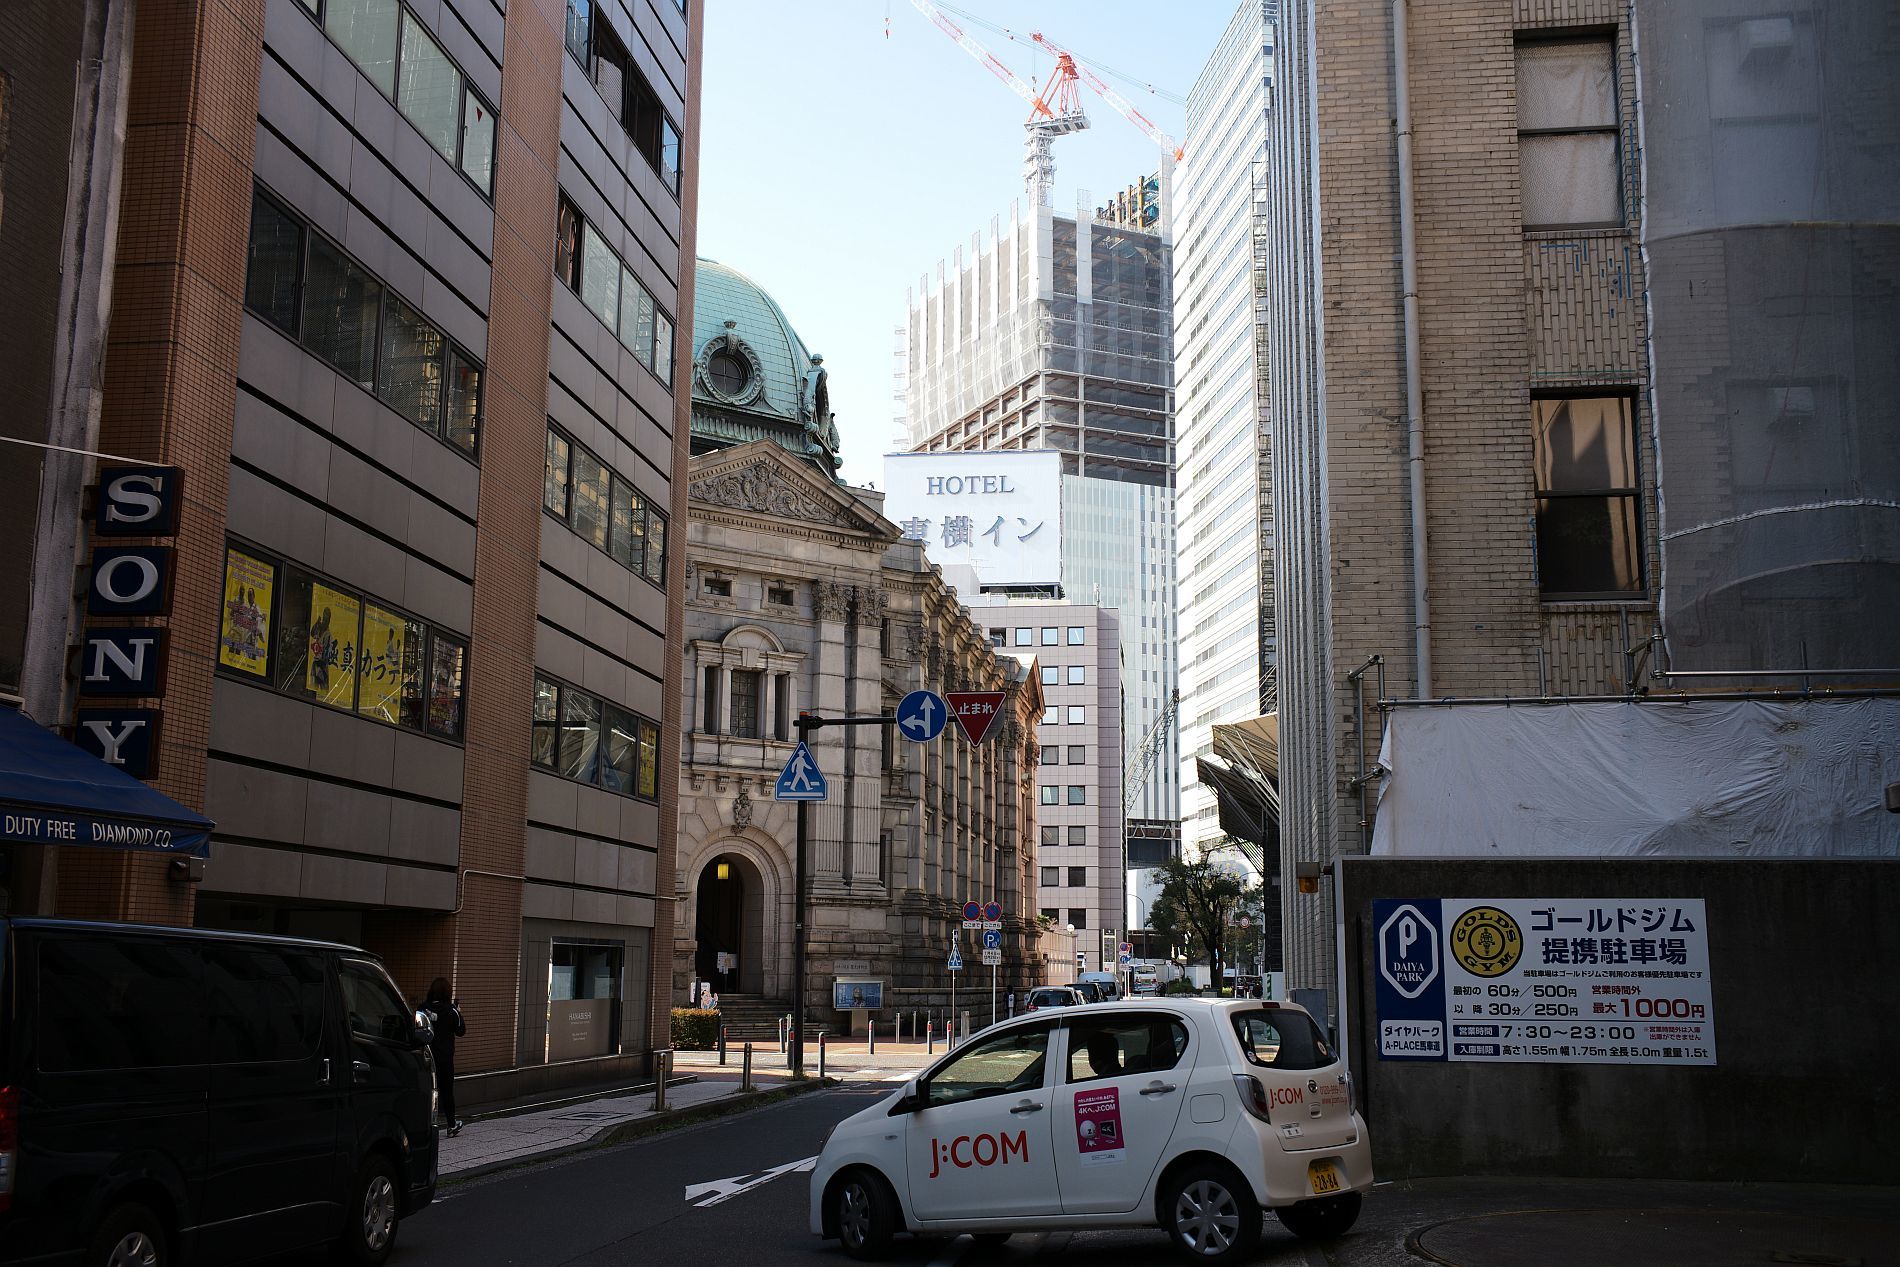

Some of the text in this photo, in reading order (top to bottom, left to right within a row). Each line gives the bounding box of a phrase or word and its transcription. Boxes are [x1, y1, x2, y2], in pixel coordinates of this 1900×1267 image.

[926, 475, 1015, 496] HOTEL
[900, 515, 1044, 549] 東横イン
[82, 474, 163, 764] SONY
[957, 702, 994, 715] 止まれ
[5, 815, 41, 838] DUTY
[46, 818, 76, 840] FREE
[91, 821, 154, 847] DIAMOND
[1457, 912, 1517, 943] GOLD'S
[1531, 907, 1696, 933] ゴールドジム
[987, 935, 995, 947] P
[1541, 937, 1688, 965] 提携駐車場
[1393, 963, 1425, 972] DAIYA
[1396, 972, 1423, 982] PARK
[1453, 985, 1482, 996] 最初の
[1591, 985, 1641, 996] 営業時間外
[1384, 1026, 1440, 1037] ダイヤパーク
[1458, 1026, 1493, 1036] 営業時間
[1269, 1088, 1304, 1109] J:COM
[929, 1130, 1029, 1178] J:COM
